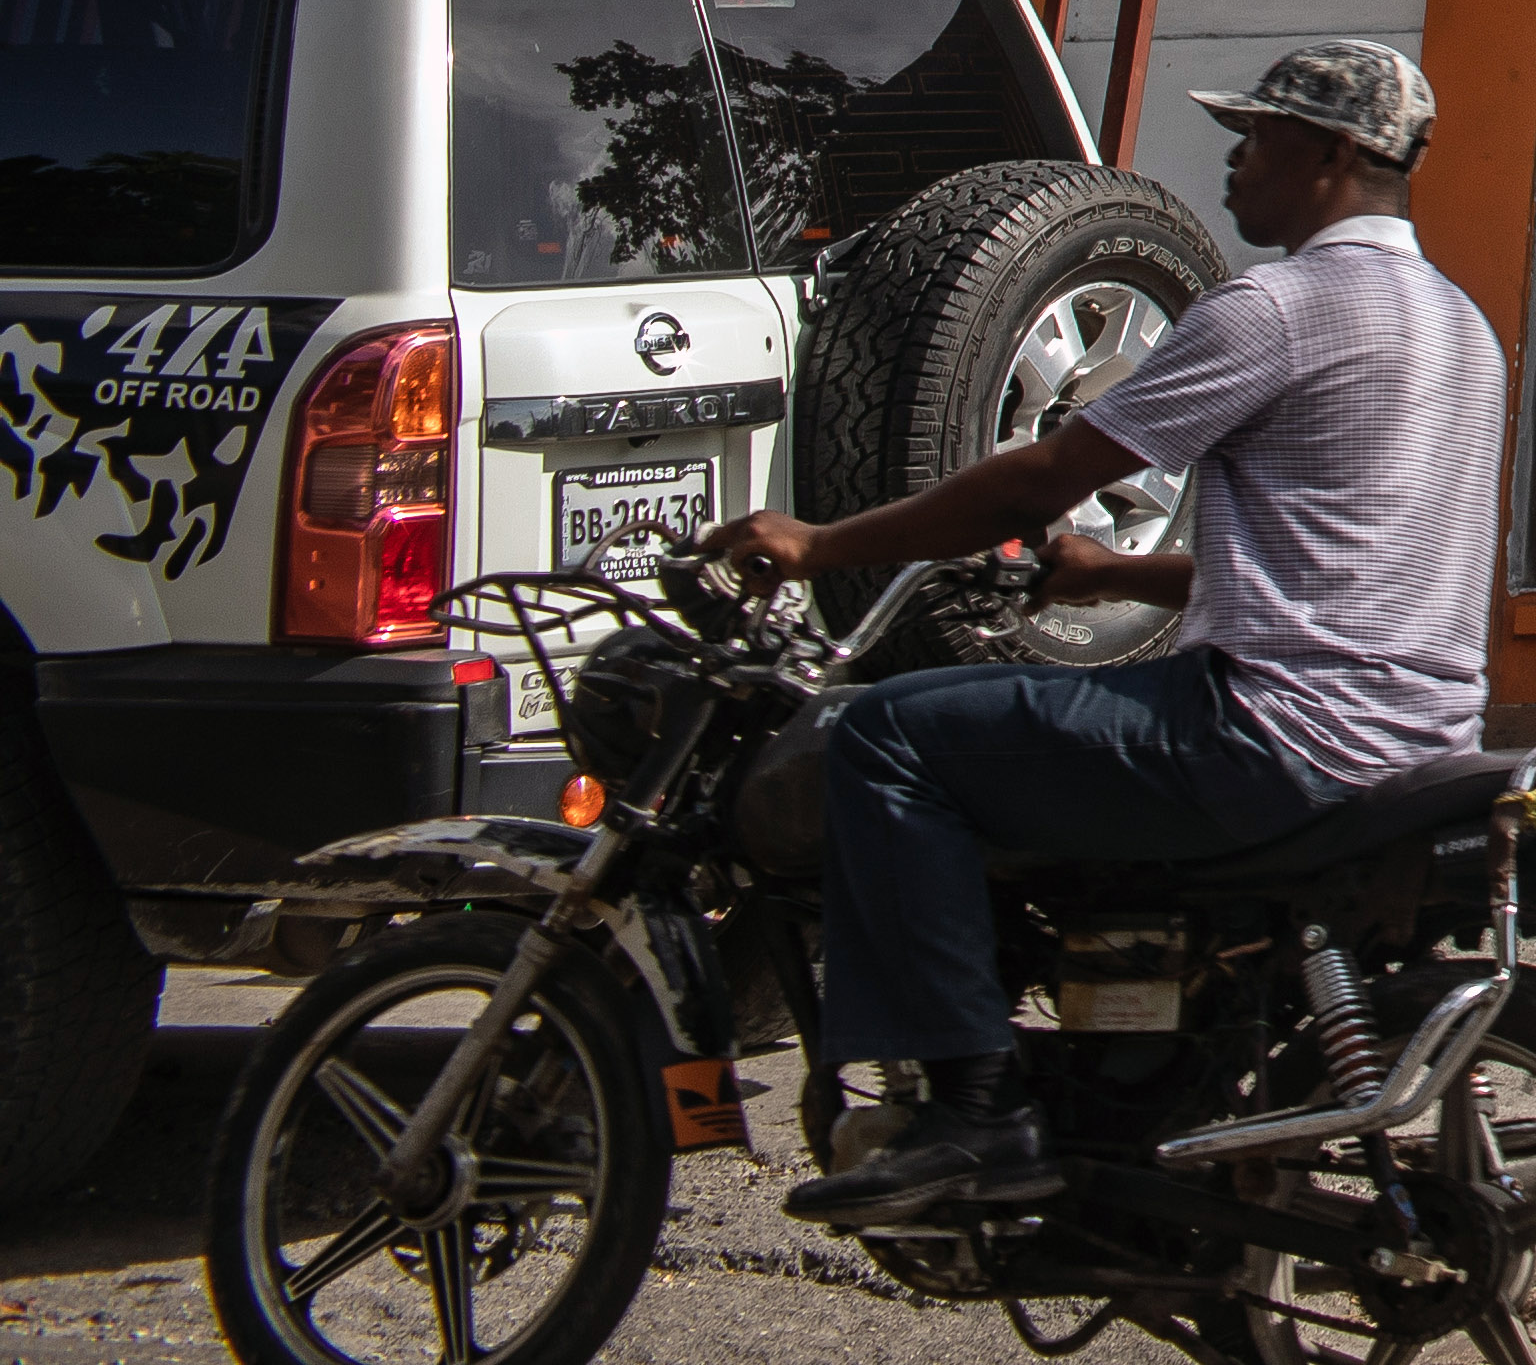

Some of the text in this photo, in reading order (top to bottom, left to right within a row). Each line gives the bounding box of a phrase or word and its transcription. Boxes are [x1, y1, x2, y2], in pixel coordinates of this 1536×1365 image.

[1088, 237, 1207, 299] ADVENT
[94, 378, 261, 413] OFF ROAD
[583, 392, 751, 433] PATROL
[600, 556, 660, 571] UNIVERS
[604, 566, 650, 580] MOTORS
[1040, 618, 1094, 645] GT
